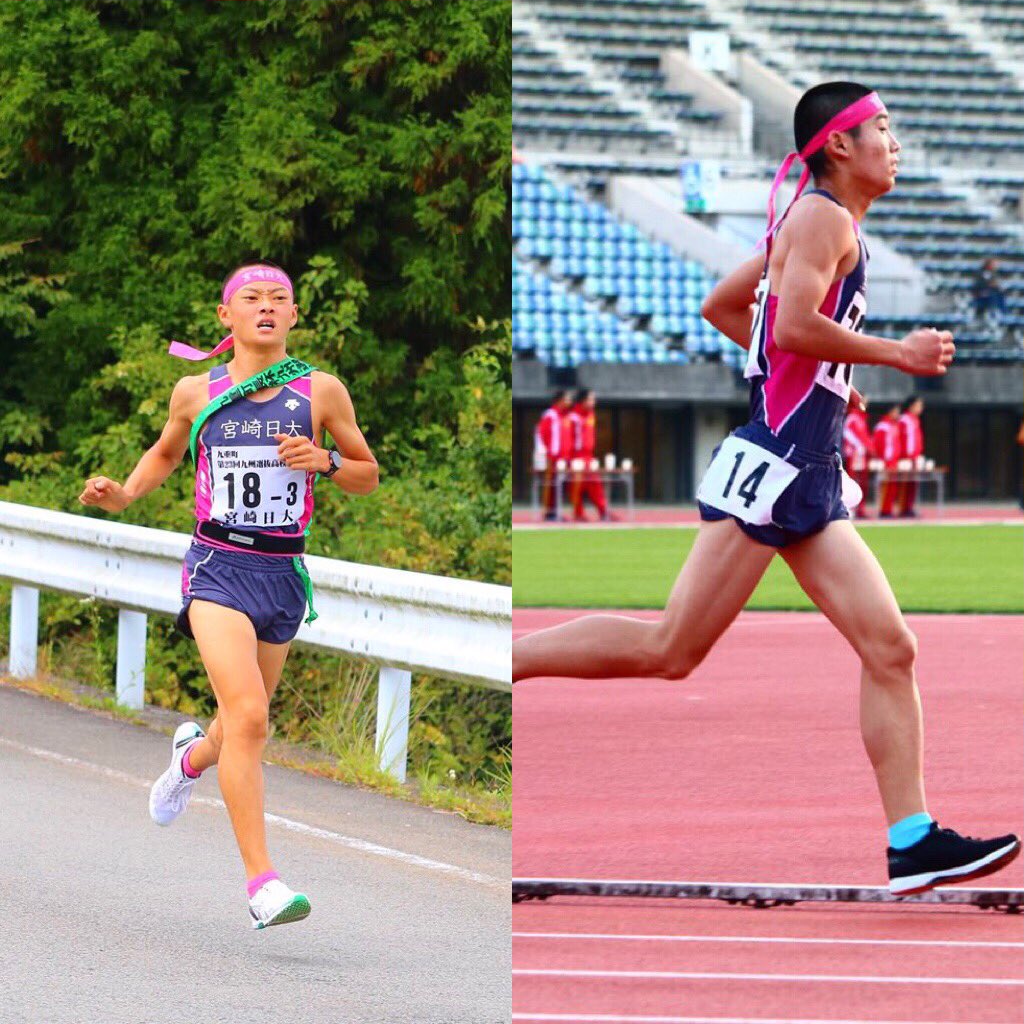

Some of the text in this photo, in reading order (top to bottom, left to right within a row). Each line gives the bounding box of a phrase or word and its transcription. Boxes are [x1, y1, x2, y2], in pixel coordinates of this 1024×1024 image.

[221, 419, 303, 439] 宮崎日大
[722, 451, 770, 509] 14
[225, 511, 294, 525] 宮崎日大
